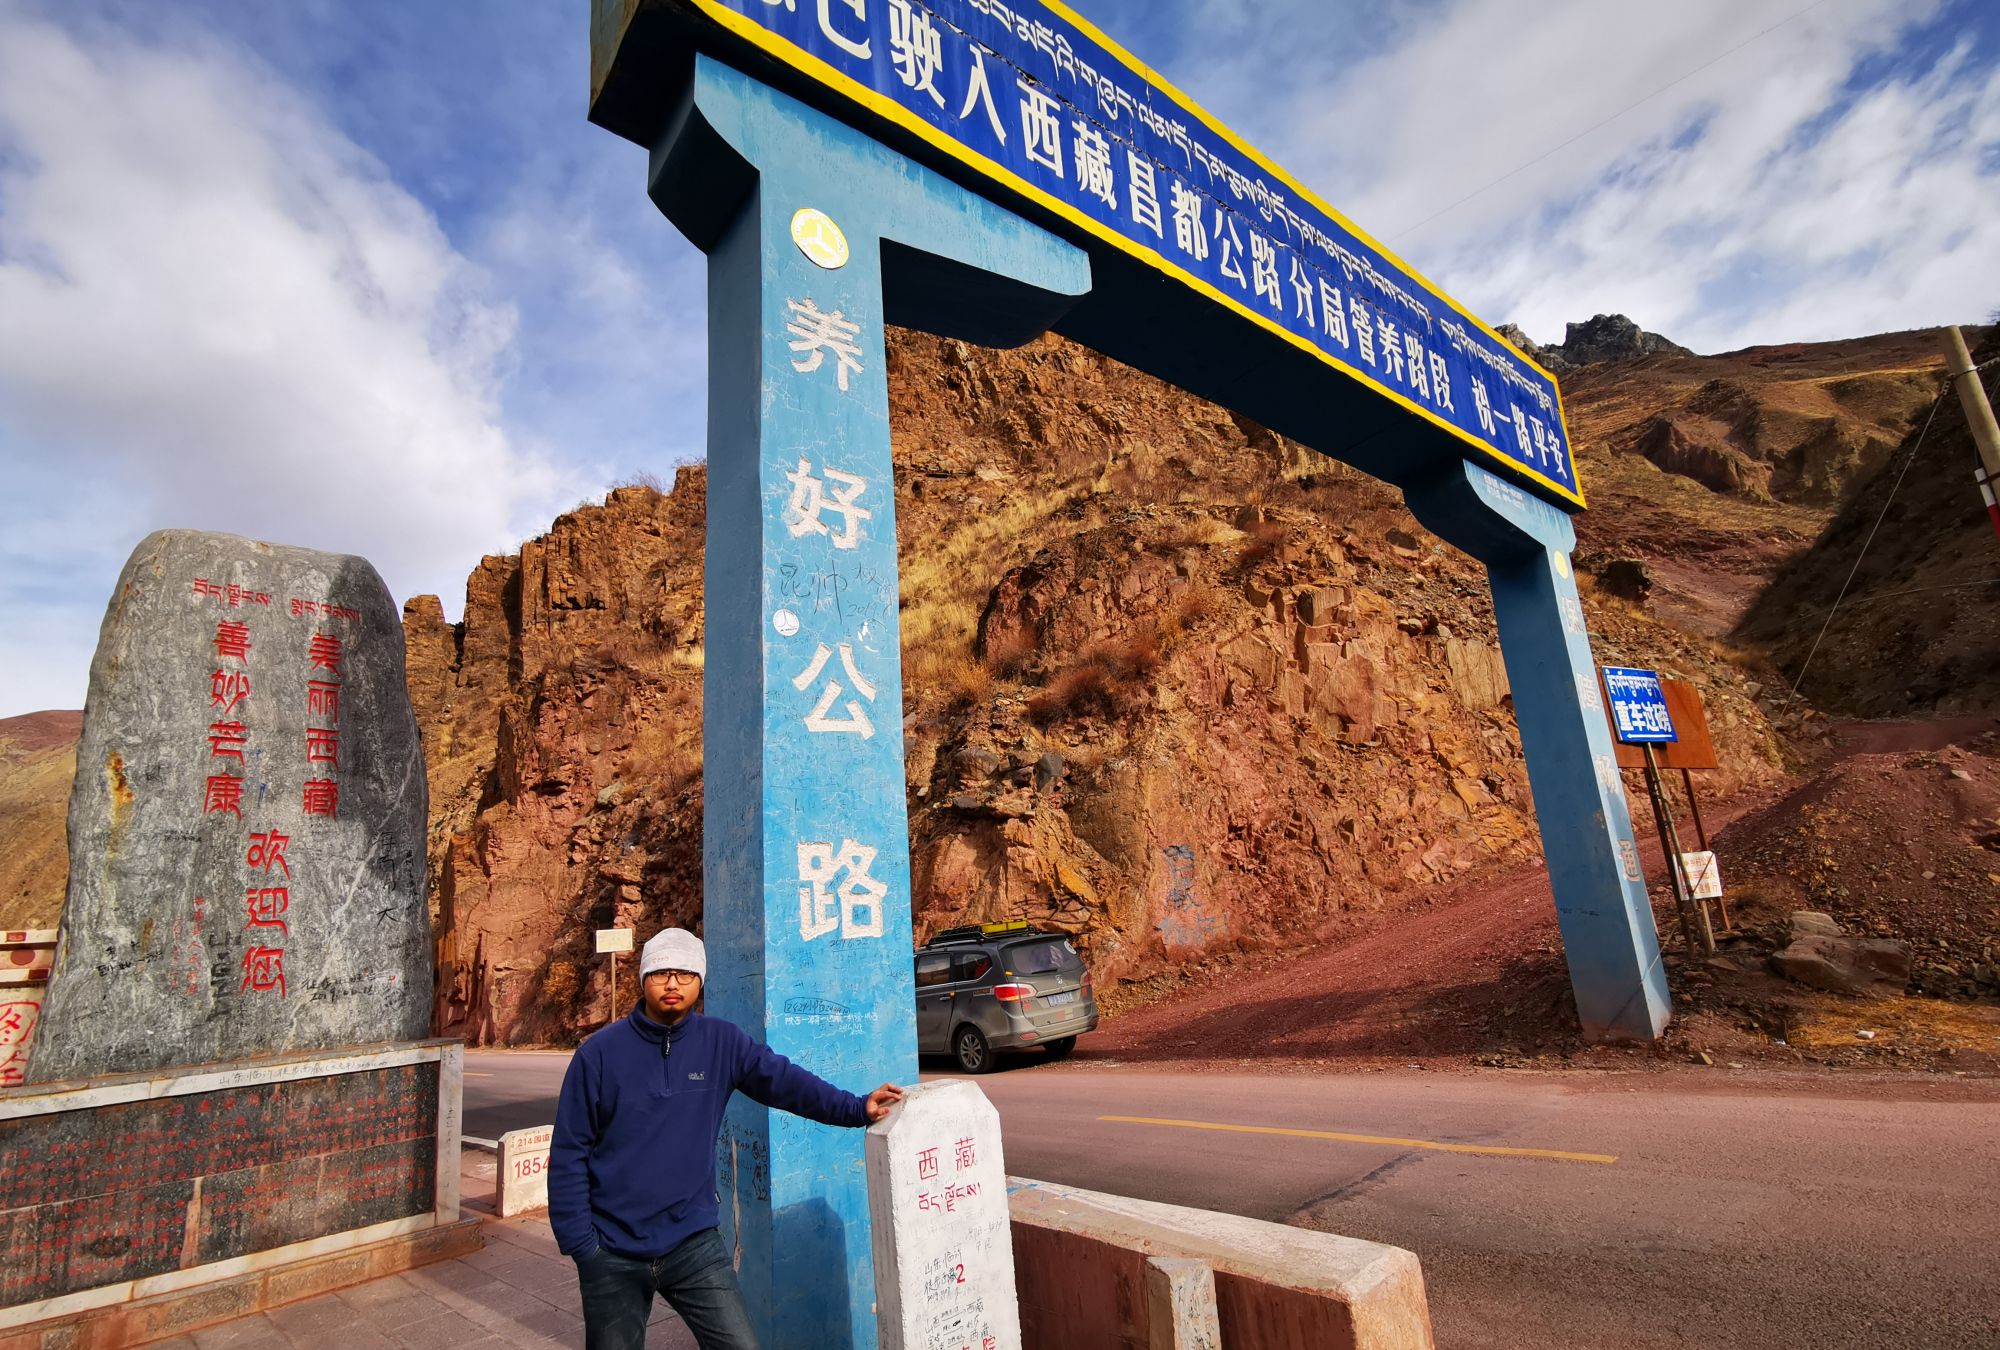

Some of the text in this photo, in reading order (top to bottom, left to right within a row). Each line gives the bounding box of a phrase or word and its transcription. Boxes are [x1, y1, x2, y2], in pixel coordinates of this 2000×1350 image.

[762, 0, 1569, 479] 已驶入西藏昌都公路分局管养路段 祝一路平安
[787, 296, 888, 942] 养好公路
[203, 620, 252, 820] 善妙芒康
[303, 630, 343, 822] 美丽西藏
[1614, 700, 1672, 732] 重车过磅
[241, 828, 290, 1000] 欢迎您
[915, 1137, 977, 1180] 西藏
[955, 1263, 966, 1284] 2
